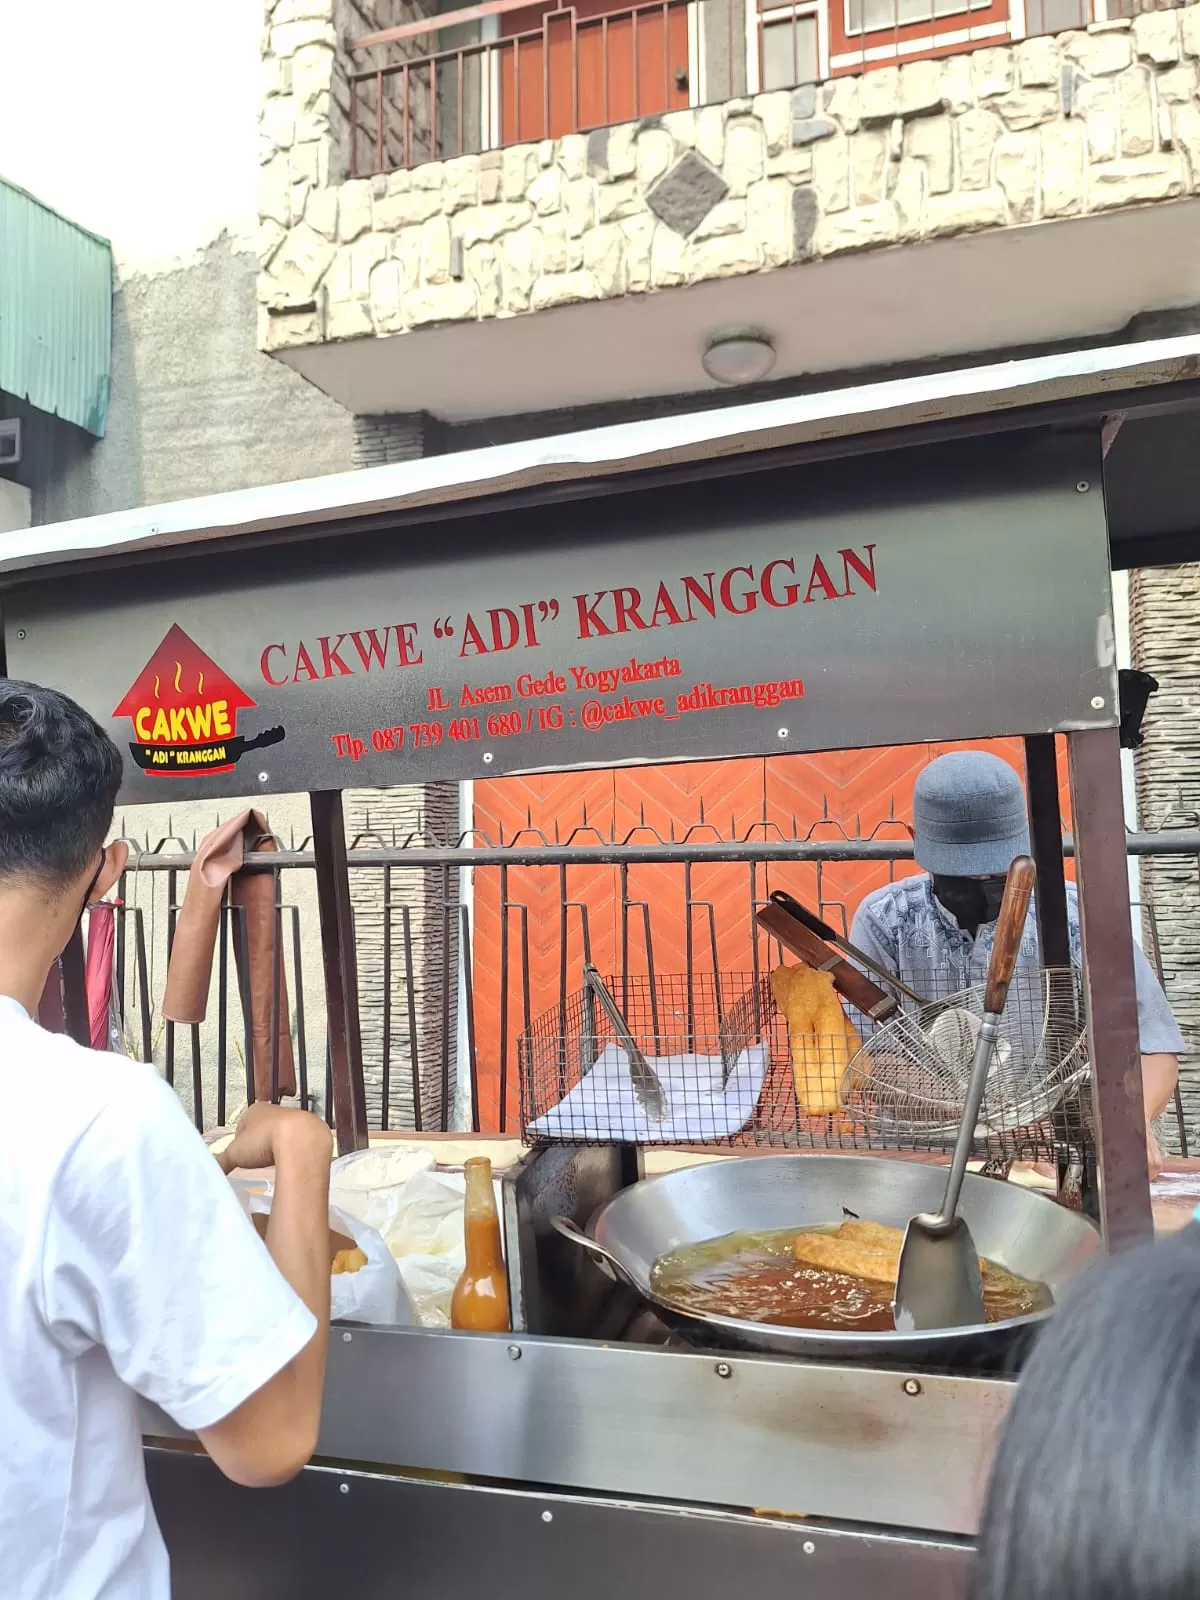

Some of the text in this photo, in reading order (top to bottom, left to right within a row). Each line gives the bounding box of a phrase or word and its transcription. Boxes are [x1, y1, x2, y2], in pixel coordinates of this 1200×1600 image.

[260, 623, 423, 686] CAKWE
[573, 544, 877, 639] KRANGGAN
[460, 683, 512, 707] Asem
[516, 671, 566, 697] Gede
[569, 656, 681, 692] Yogyakarta
[136, 700, 231, 741] CAKWE
[331, 733, 369, 761] Tlp.
[372, 726, 404, 753] 087
[409, 722, 443, 748] 739
[448, 716, 480, 742] 401
[487, 711, 522, 736] 680
[538, 705, 563, 730] IG
[581, 677, 805, 730] @cakwe_adikranggan
[176, 746, 226, 764] KRANGGAN
